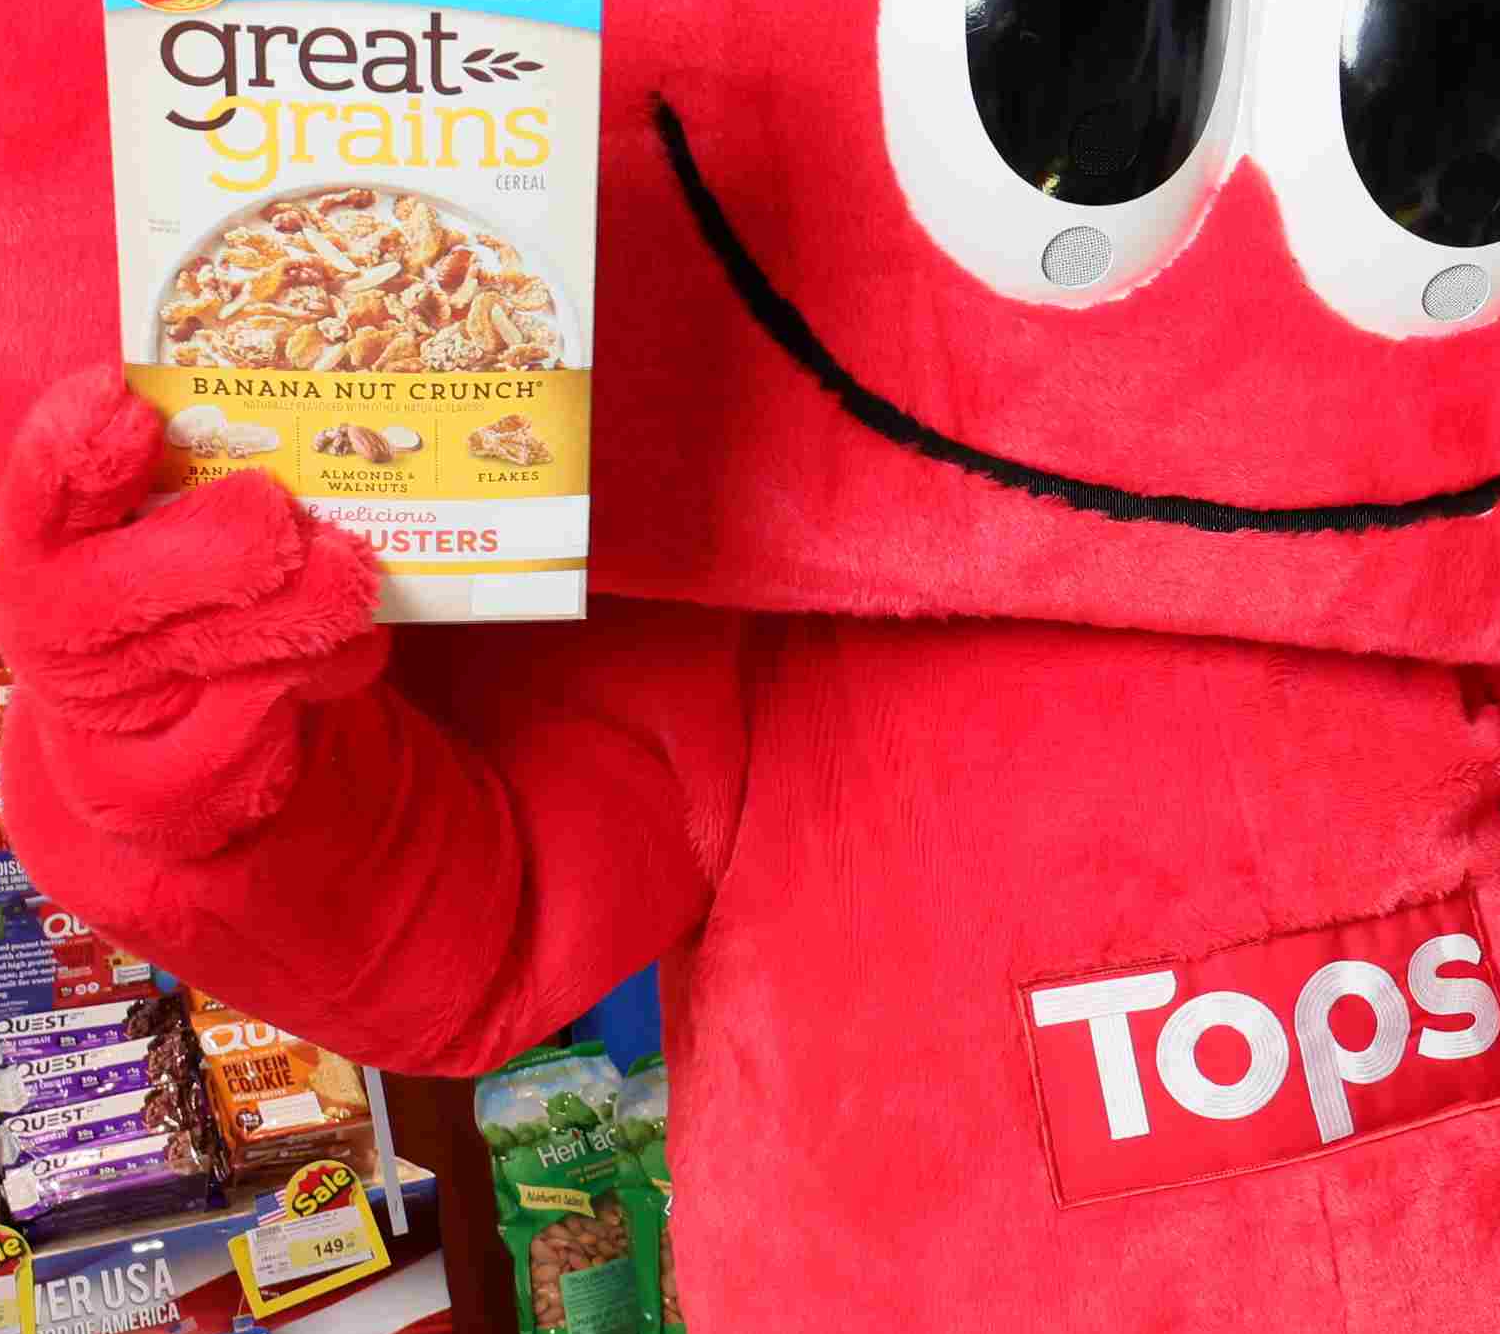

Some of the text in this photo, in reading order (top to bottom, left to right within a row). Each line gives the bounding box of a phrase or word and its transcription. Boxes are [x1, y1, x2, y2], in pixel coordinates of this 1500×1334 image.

[159, 11, 462, 131] great
[204, 93, 551, 194] grains
[494, 172, 548, 193] CEREAL
[193, 377, 396, 400] BANANA NUT
[319, 469, 403, 482] ALMONDS
[476, 470, 540, 483] FLAKES
[327, 481, 408, 493] WALNUTS
[330, 506, 437, 524] delicious
[227, 1070, 296, 1094] COOKIE
[293, 1166, 354, 1218] Sale
[313, 1239, 344, 1259] 149
[100, 1258, 176, 1311] USA
